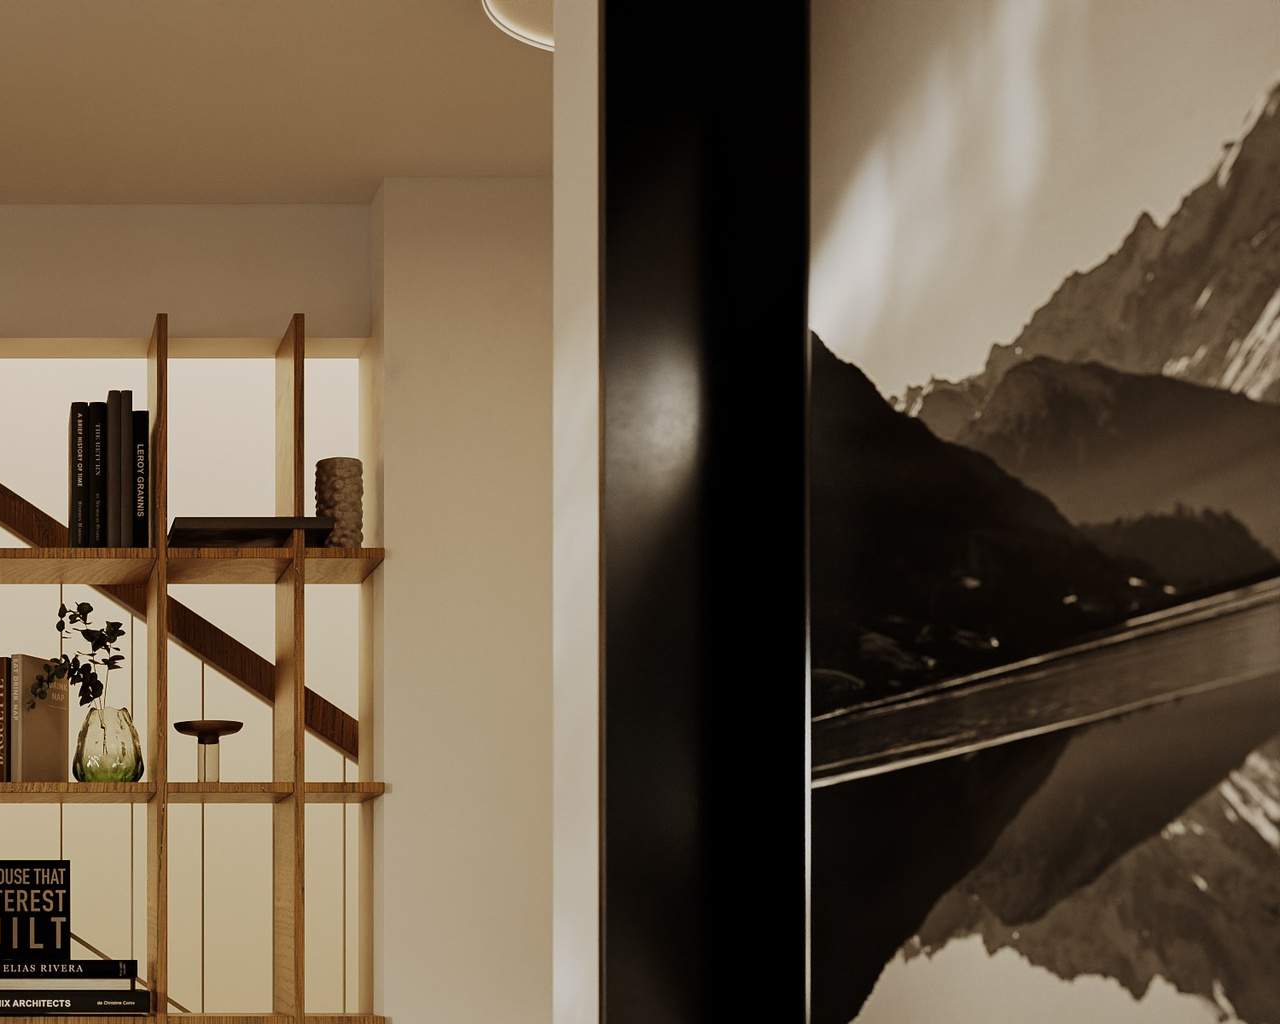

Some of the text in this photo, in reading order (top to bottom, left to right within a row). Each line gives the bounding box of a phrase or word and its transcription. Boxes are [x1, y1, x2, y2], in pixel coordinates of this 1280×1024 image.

[77, 463, 83, 472] OF
[136, 443, 145, 518] LEROY GRANNIS
[51, 692, 65, 700] NAP
[33, 868, 67, 885] THAT
[3, 964, 84, 973] ELIAS RIVERA
[12, 999, 71, 1008] ARCHITECTS
